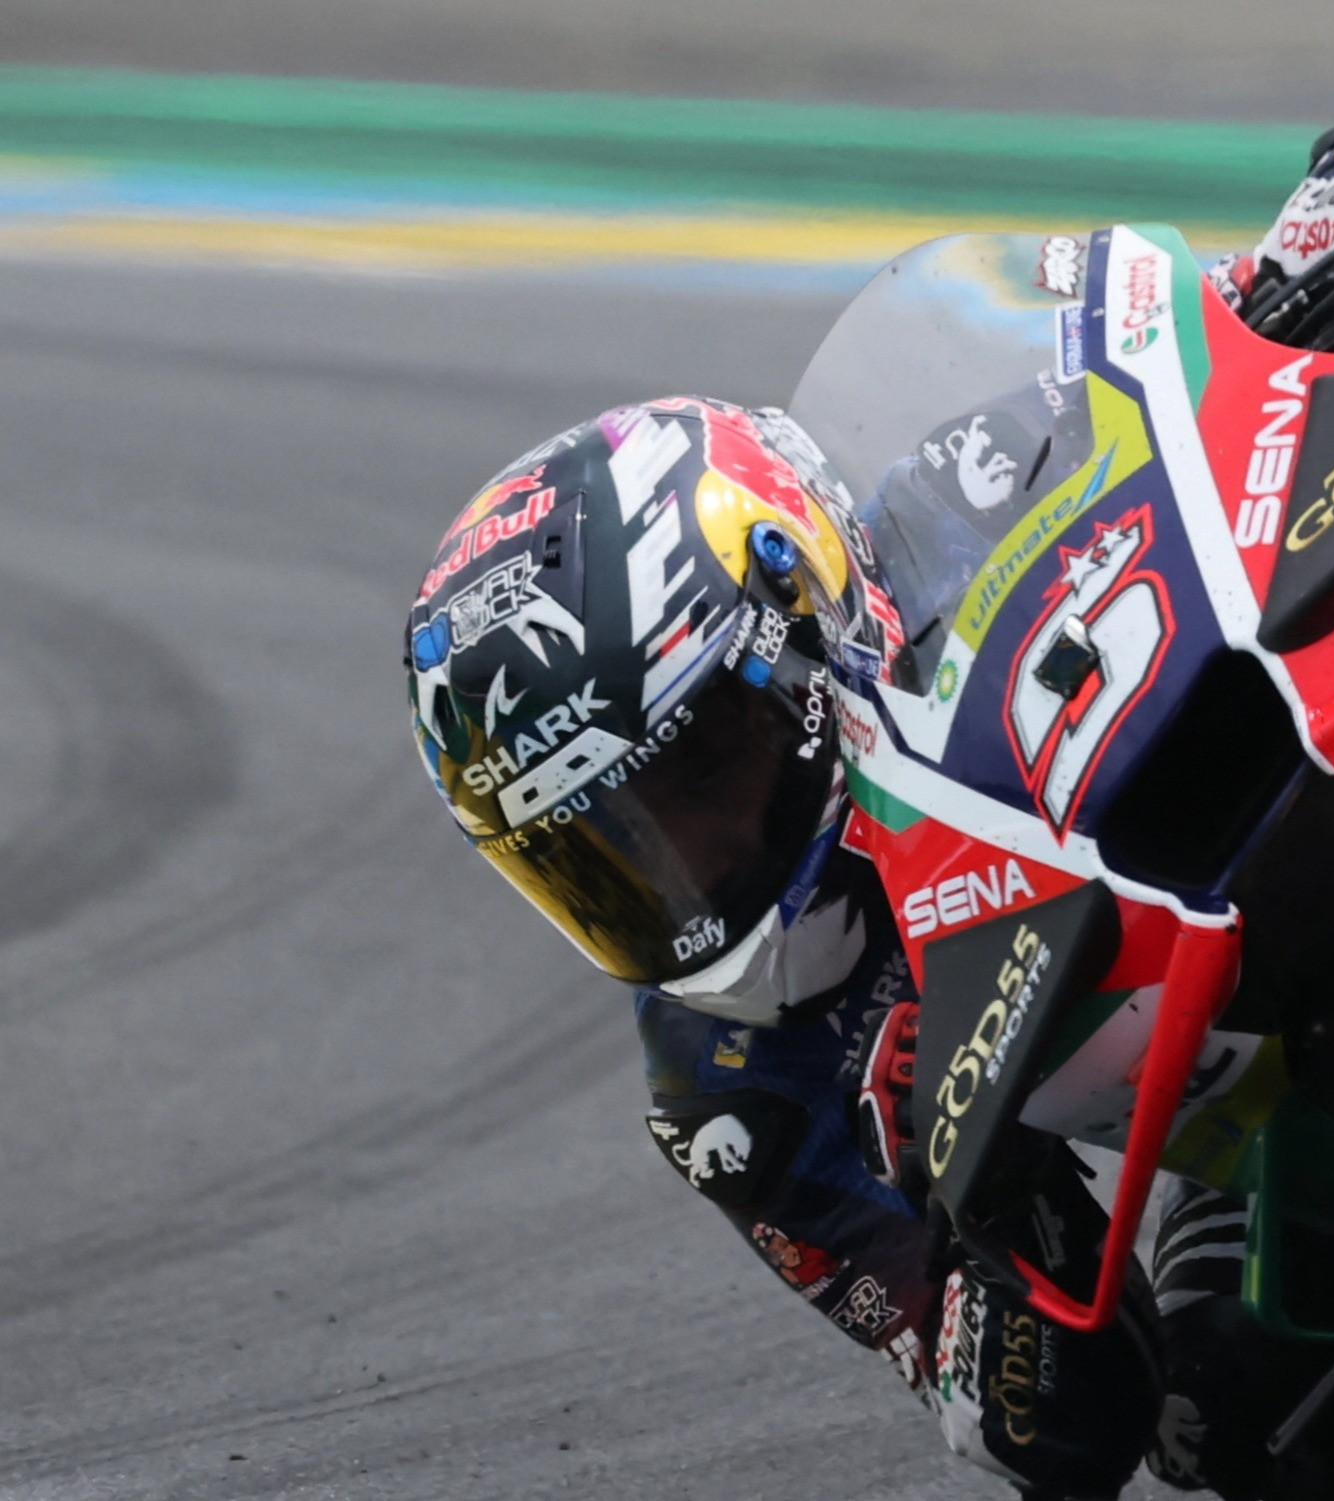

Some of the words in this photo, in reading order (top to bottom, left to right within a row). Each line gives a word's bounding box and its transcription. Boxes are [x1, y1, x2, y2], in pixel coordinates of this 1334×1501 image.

[1234, 354, 1313, 548] SENA
[473, 486, 556, 559] Bull
[752, 606, 778, 656] QUAD
[764, 618, 790, 665] LOCK
[462, 678, 612, 796] SHARK
[479, 830, 530, 859] GIVES
[535, 791, 592, 834] YOU
[598, 703, 695, 790] WINGS
[904, 858, 1036, 939] SENA
[672, 917, 727, 962] Dafy
[985, 942, 1051, 1086] SPORTS
